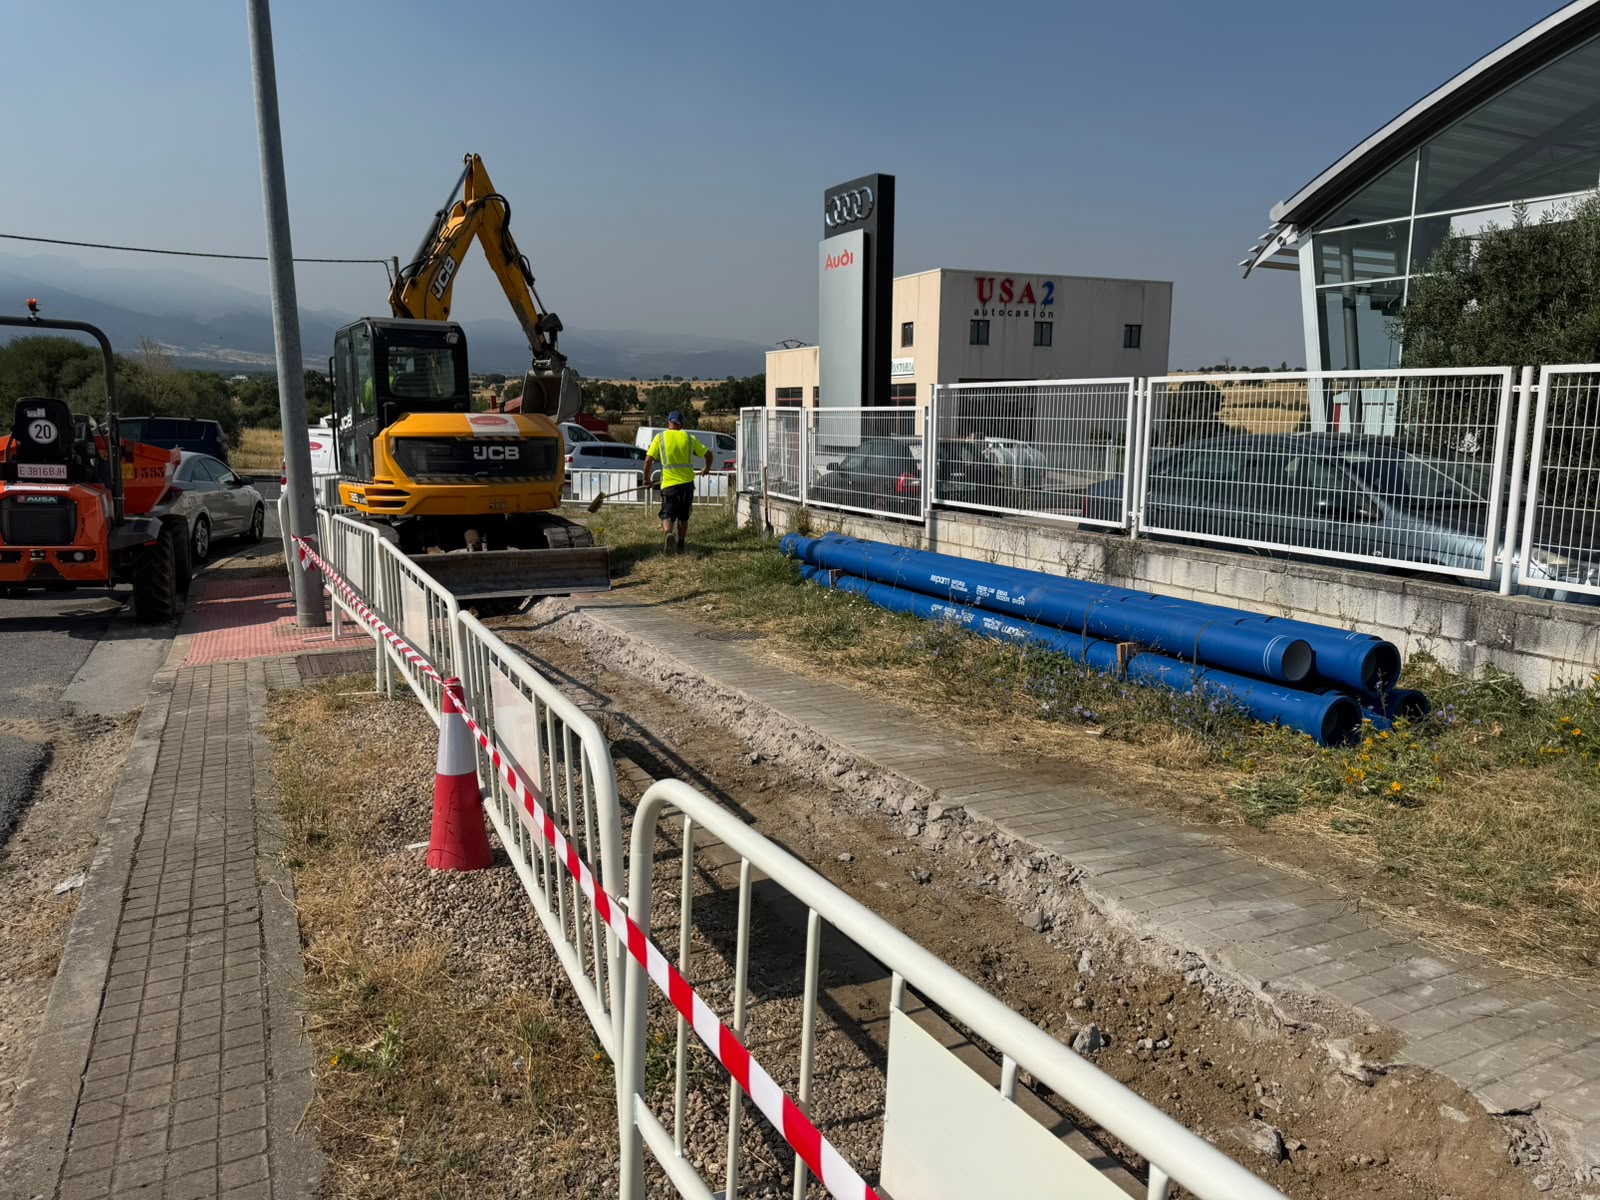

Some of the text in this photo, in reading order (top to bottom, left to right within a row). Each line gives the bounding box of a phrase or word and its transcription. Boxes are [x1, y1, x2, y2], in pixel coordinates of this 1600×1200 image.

[825, 249, 854, 270] Audi
[431, 255, 456, 299] JCB
[34, 424, 52, 439] 20
[473, 445, 520, 460] JCB
[27, 495, 56, 503] AUSA
